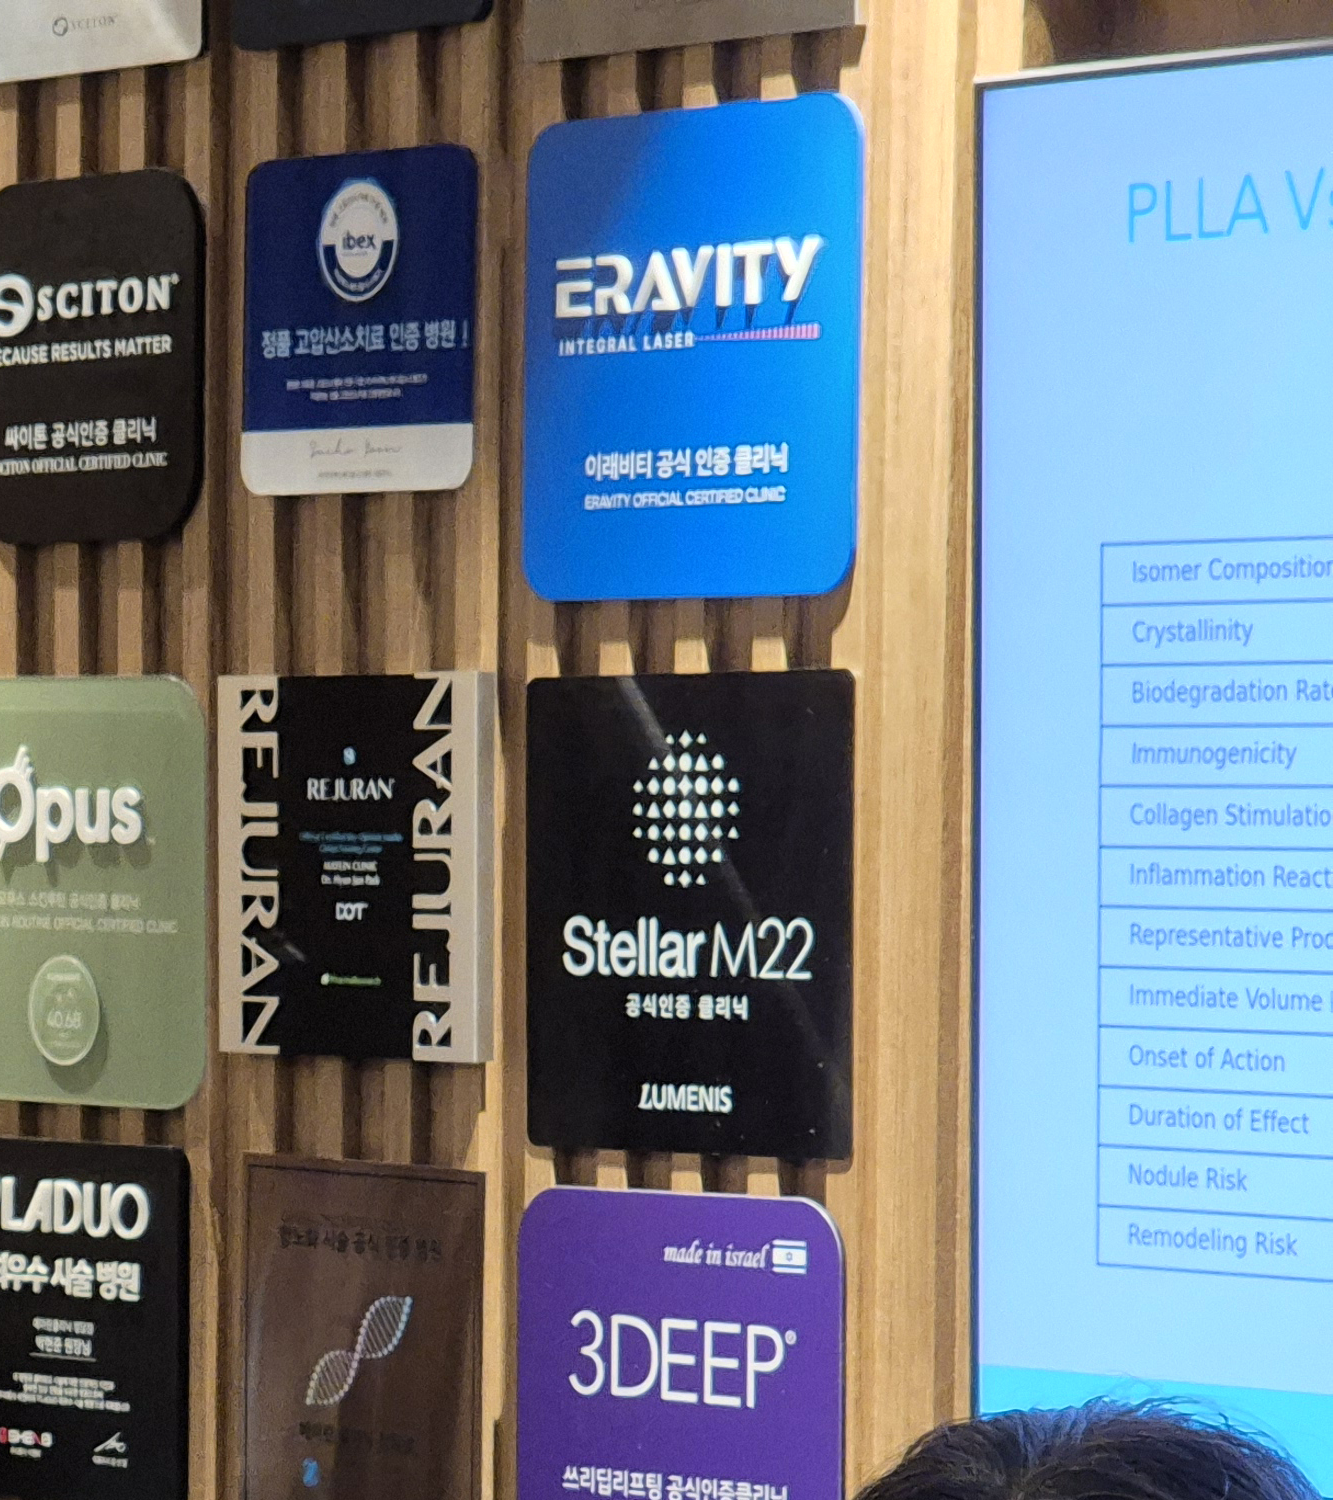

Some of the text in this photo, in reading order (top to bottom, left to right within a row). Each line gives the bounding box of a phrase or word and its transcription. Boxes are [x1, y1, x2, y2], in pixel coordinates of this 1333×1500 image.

[1128, 166, 1333, 243] PLLA V
[555, 233, 824, 319] ERAVITY
[51, 338, 112, 363] RESULTS
[114, 334, 173, 357] MATTER
[389, 321, 421, 351] 인증
[424, 319, 457, 350] 병원
[558, 330, 695, 357] INTEGRAL LASER
[4, 416, 157, 451] 싸이톤 공식인증 클리닉
[31, 455, 79, 475] OFFICIAL
[79, 452, 131, 472] CERTIFIED
[132, 451, 169, 469] CLINIC
[655, 446, 691, 479] 공식
[695, 445, 732, 477] 인증
[734, 442, 789, 476] 클리닉
[584, 485, 787, 511] ERAVITY OFFICIAL CERTIFIED CLINIC
[1132, 560, 1202, 583] Isomer
[1132, 618, 1254, 649] Crystallinity
[1132, 678, 1333, 709] Biodegradation Rat
[1131, 740, 1298, 771] Immunogenicity
[307, 776, 395, 801] REJURAN
[1129, 802, 1218, 832] Collagen
[1129, 861, 1266, 888] Inflammation
[561, 914, 815, 980] Stellar M22
[1129, 922, 1284, 951] Representative
[624, 992, 749, 1021] 공식인증 클리닉
[1129, 983, 1239, 1009] Immediate
[1245, 987, 1323, 1012] Volume
[1128, 1043, 1286, 1072] Onset of Action
[637, 1082, 733, 1114] LUMENIS
[1128, 1102, 1309, 1135] Duration of Effect
[1128, 1162, 1248, 1192] Nodule Risk
[663, 1238, 770, 1270] made in israel
[1128, 1222, 1299, 1259] Remodeling Risk
[50, 1257, 95, 1299] 시술
[95, 1260, 141, 1302] 병원
